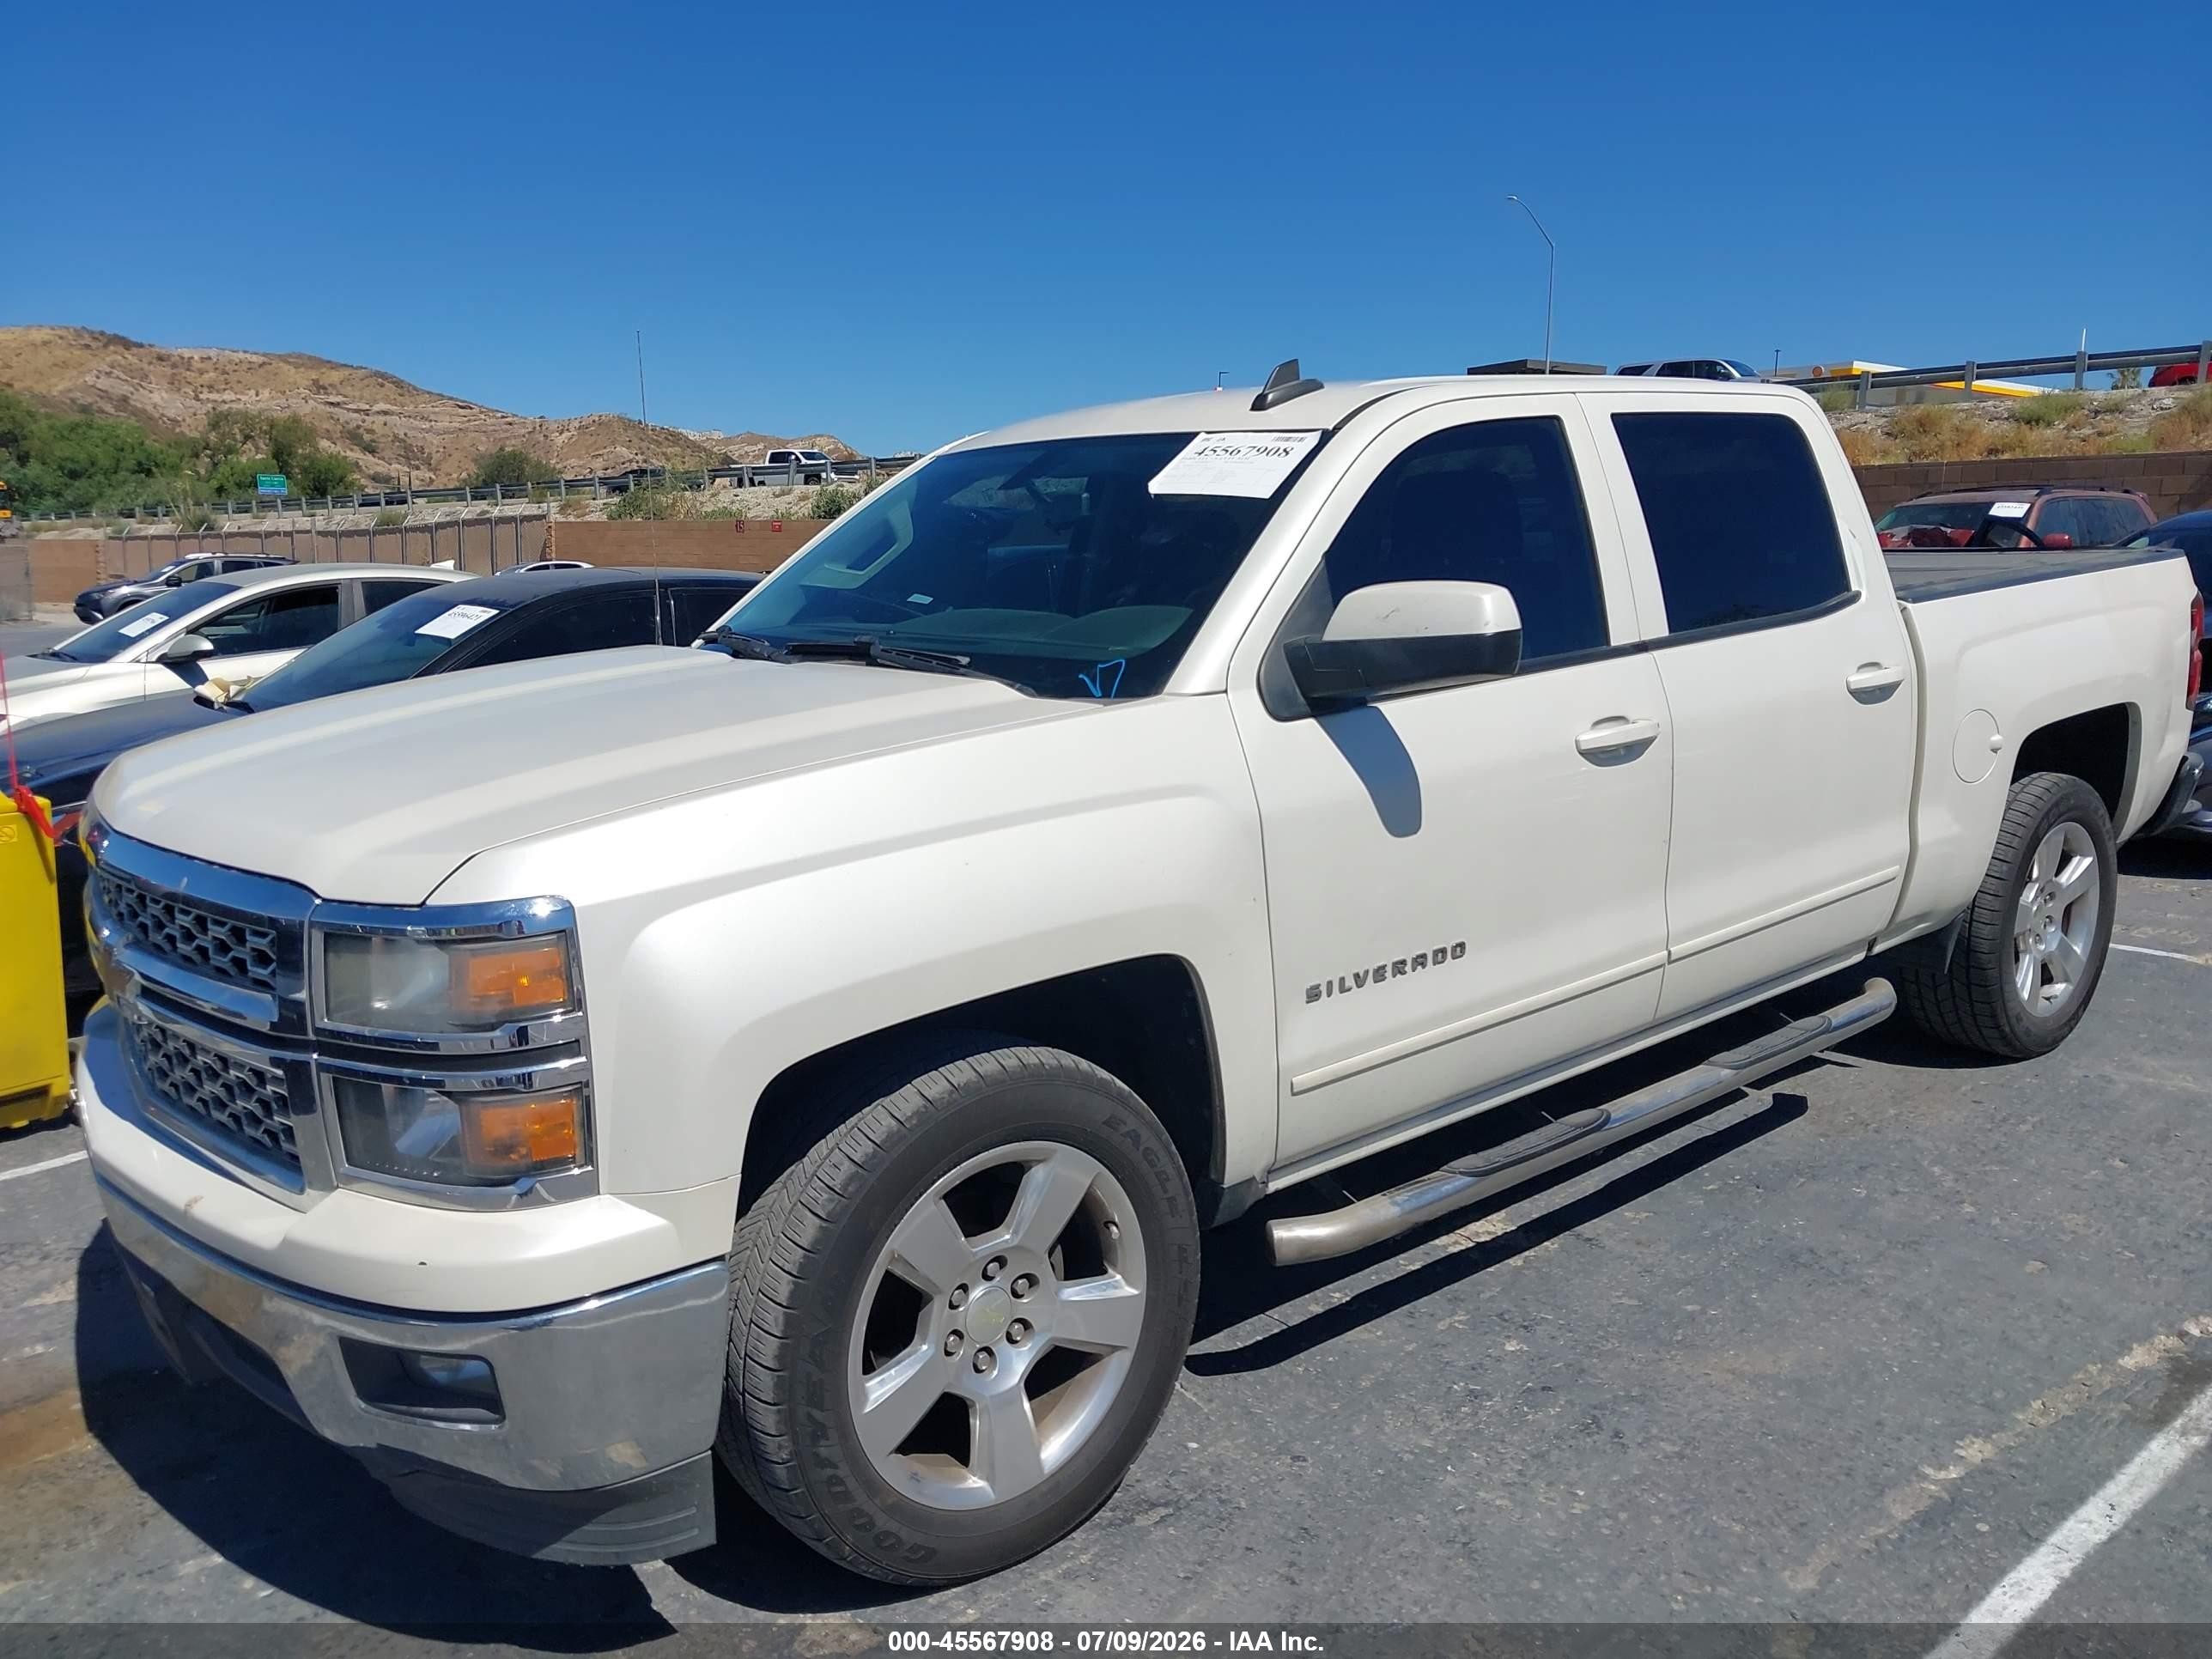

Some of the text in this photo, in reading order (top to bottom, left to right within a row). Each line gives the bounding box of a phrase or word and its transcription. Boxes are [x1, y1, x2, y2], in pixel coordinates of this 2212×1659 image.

[1194, 445, 1295, 459] 45567908
[1304, 940, 1467, 1005] SILVERADO
[1102, 1112, 1184, 1219] EAGLE
